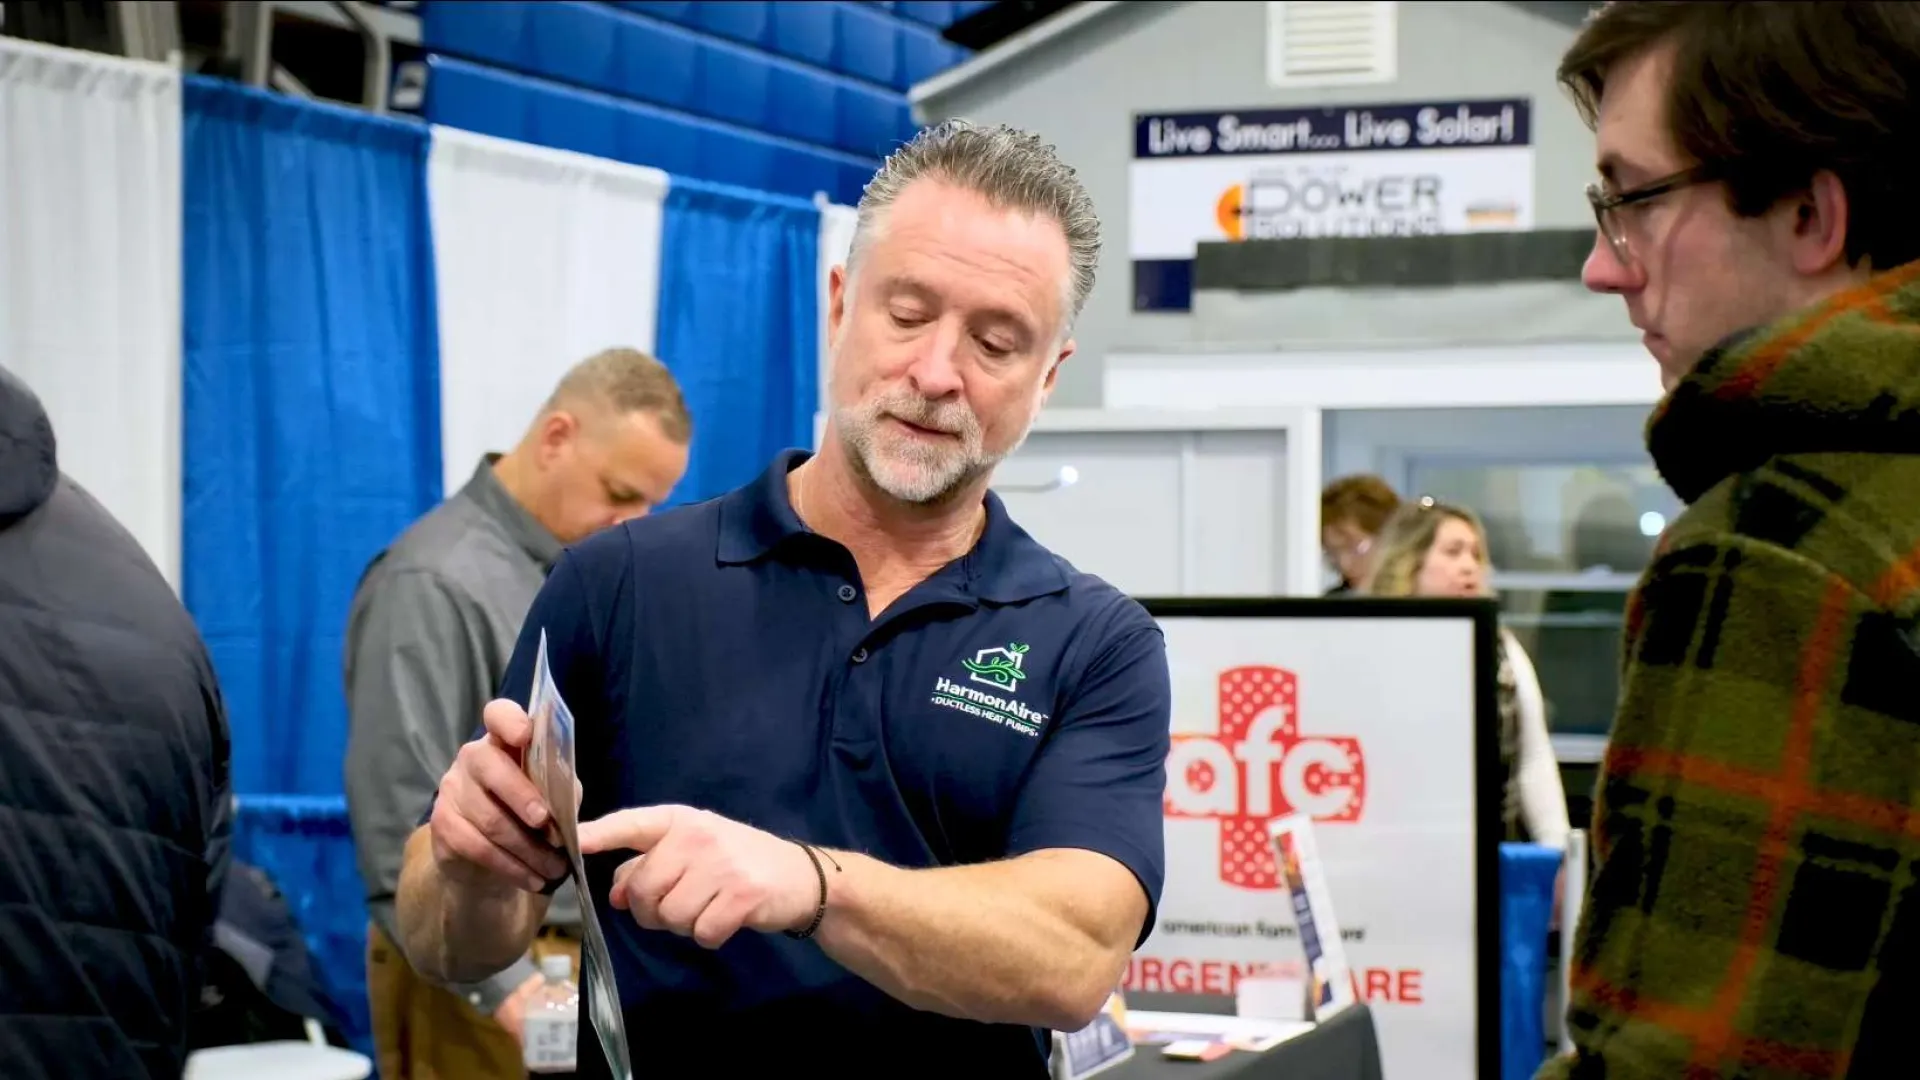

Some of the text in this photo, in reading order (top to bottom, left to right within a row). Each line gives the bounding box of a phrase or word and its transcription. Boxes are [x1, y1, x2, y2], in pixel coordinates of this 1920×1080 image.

[1149, 118, 1211, 154] Live
[1344, 109, 1410, 147] Live
[1416, 104, 1514, 145] Solar!
[981, 710, 1005, 723] HEAT
[1167, 705, 1354, 818] afc
[1255, 920, 1297, 939] fam
